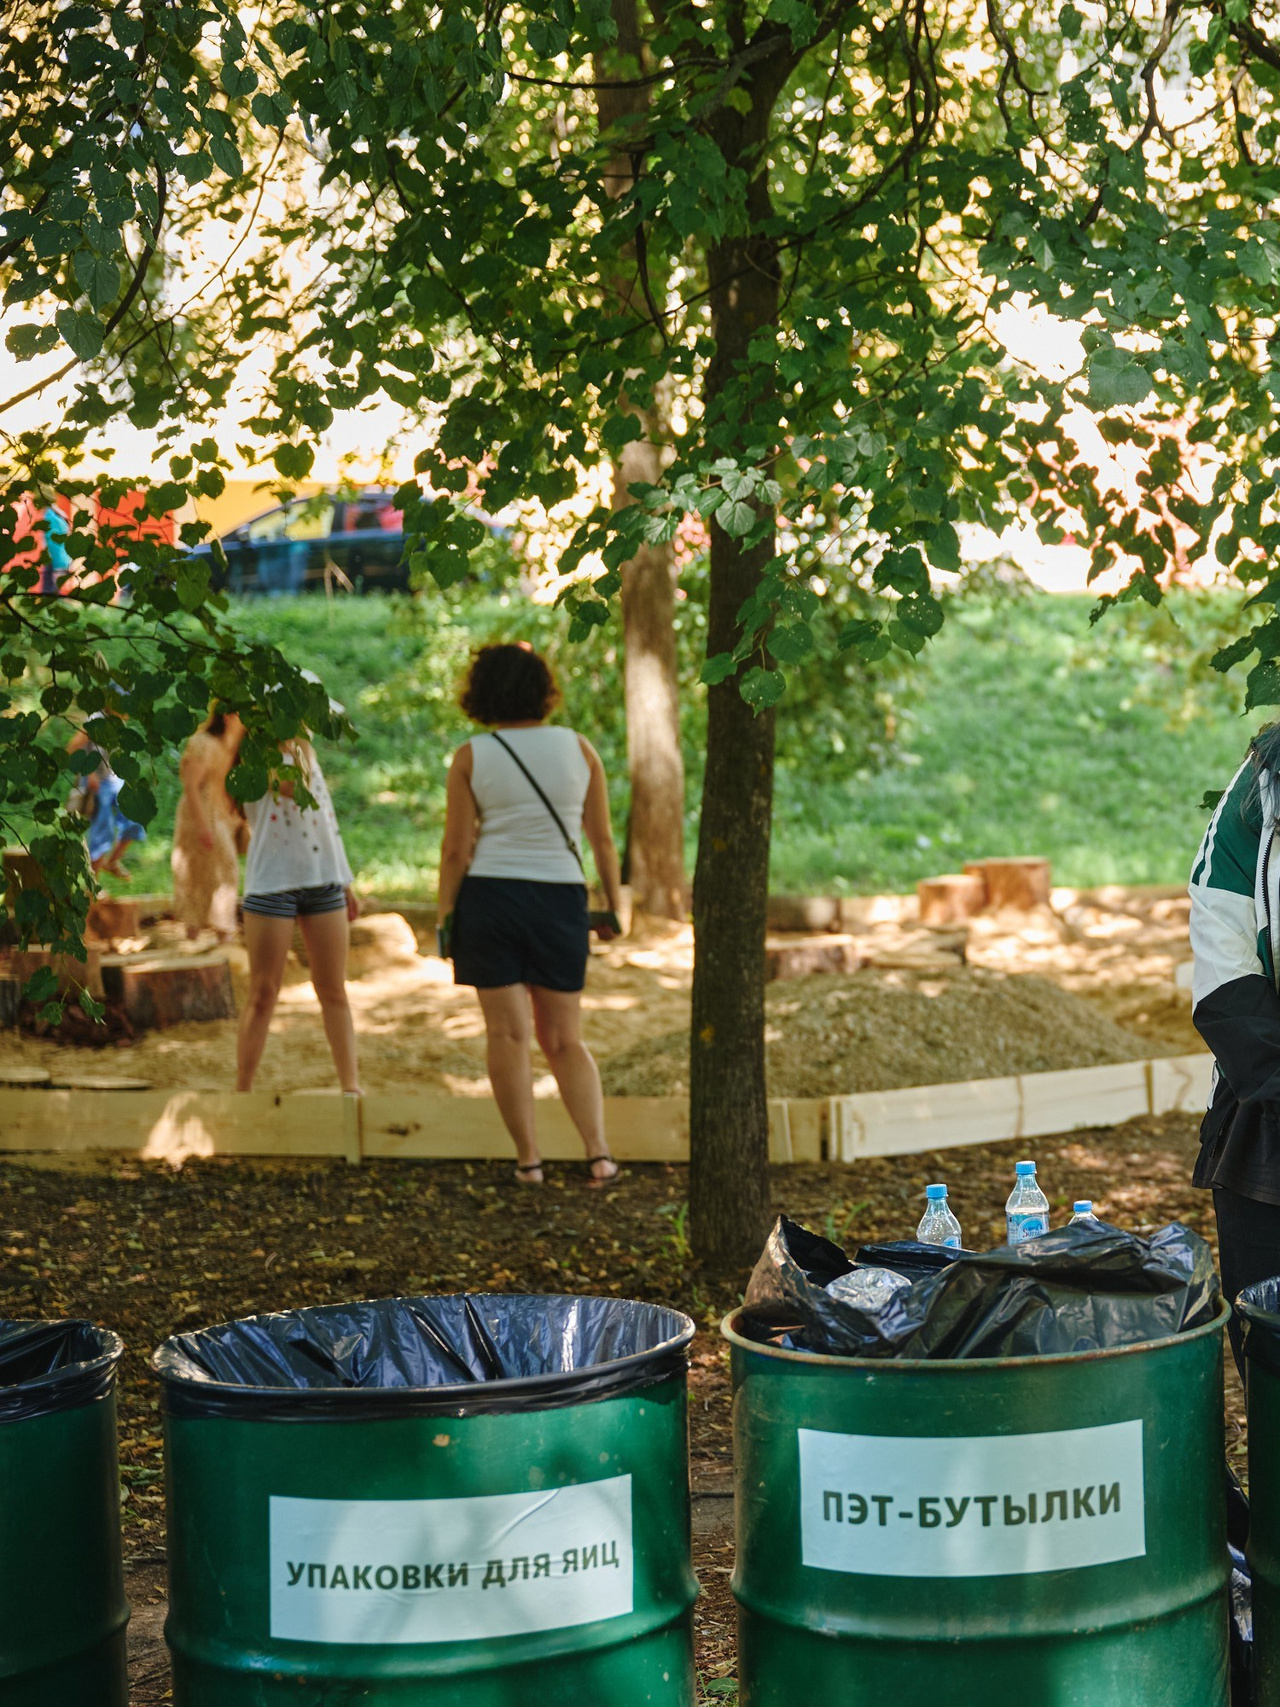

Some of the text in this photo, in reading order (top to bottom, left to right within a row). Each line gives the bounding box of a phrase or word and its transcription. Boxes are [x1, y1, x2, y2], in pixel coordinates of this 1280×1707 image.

[823, 1481, 1121, 1529] ПЭТ-БУТЫЛКИ
[287, 1540, 619, 1590] УПАКОВКИ ДЛЯ ЯИЦ
